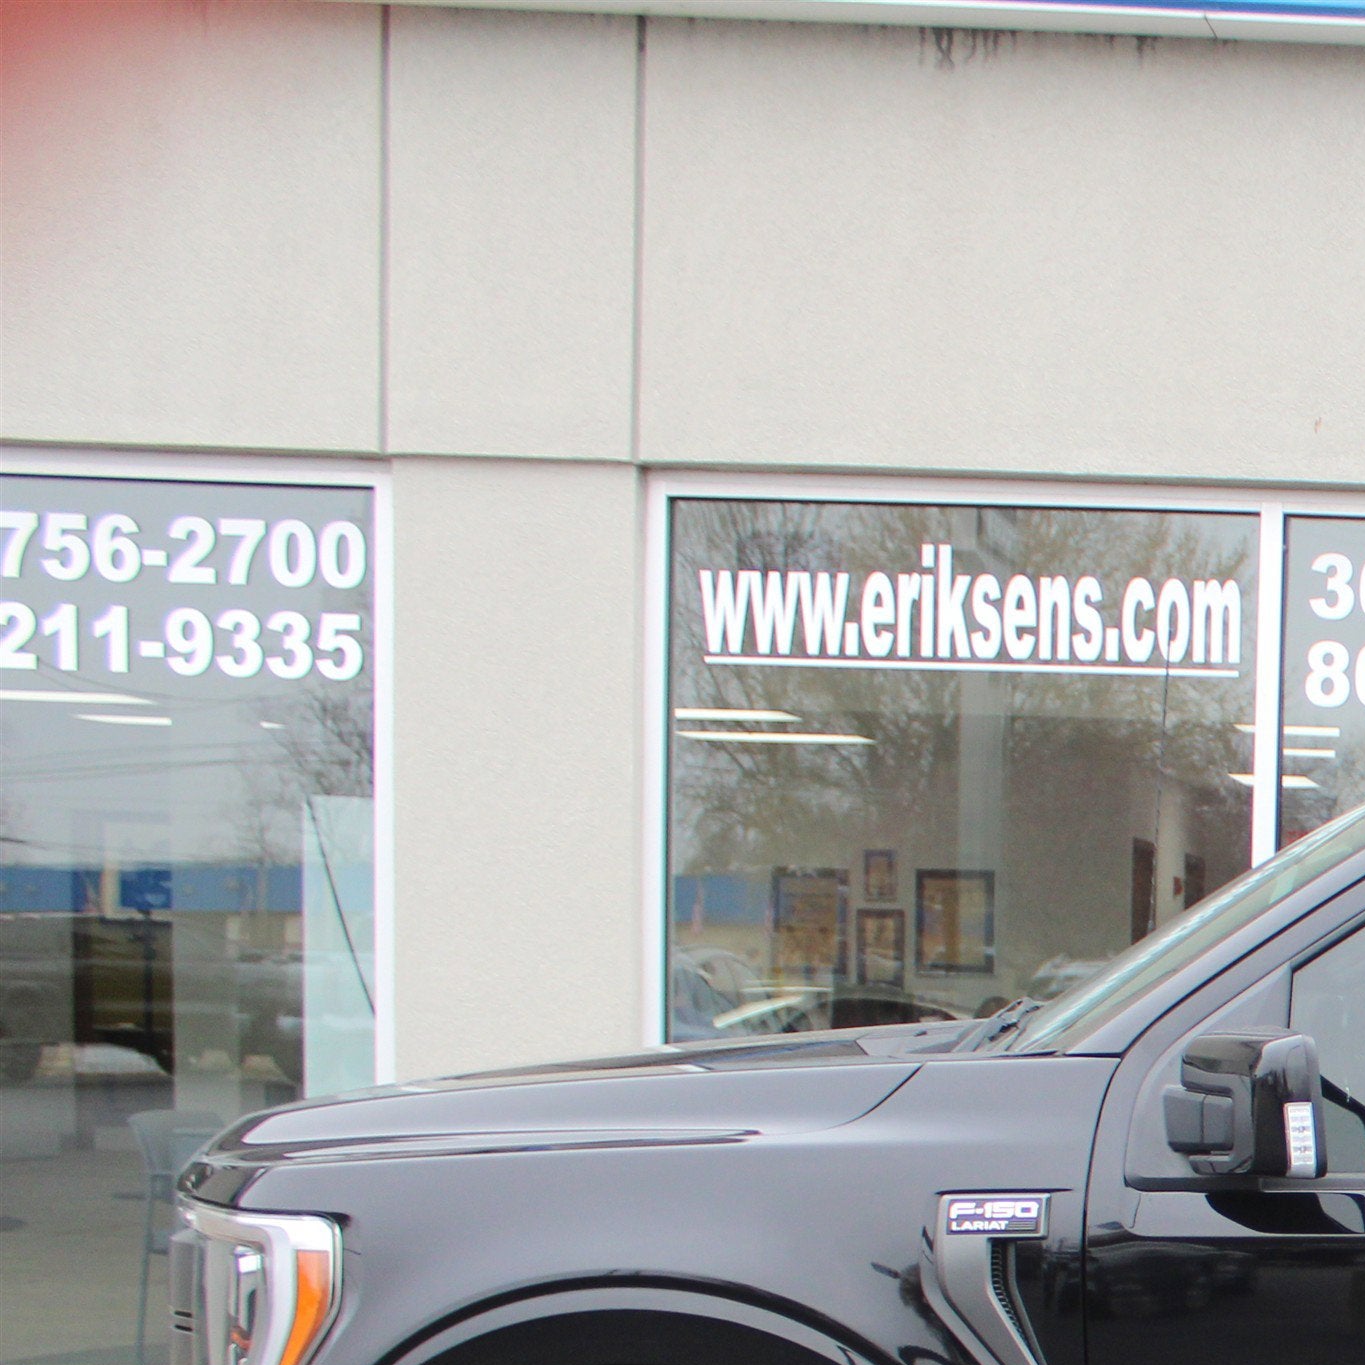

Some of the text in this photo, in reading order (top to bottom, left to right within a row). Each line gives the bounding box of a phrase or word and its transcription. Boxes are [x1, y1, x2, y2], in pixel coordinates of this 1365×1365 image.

[0, 510, 366, 589] 756-2700
[0, 601, 363, 681] 211-9335
[699, 544, 1242, 664] www.eriksens.com
[949, 1201, 1040, 1219] F-150
[951, 1220, 1009, 1231] LARIAT
